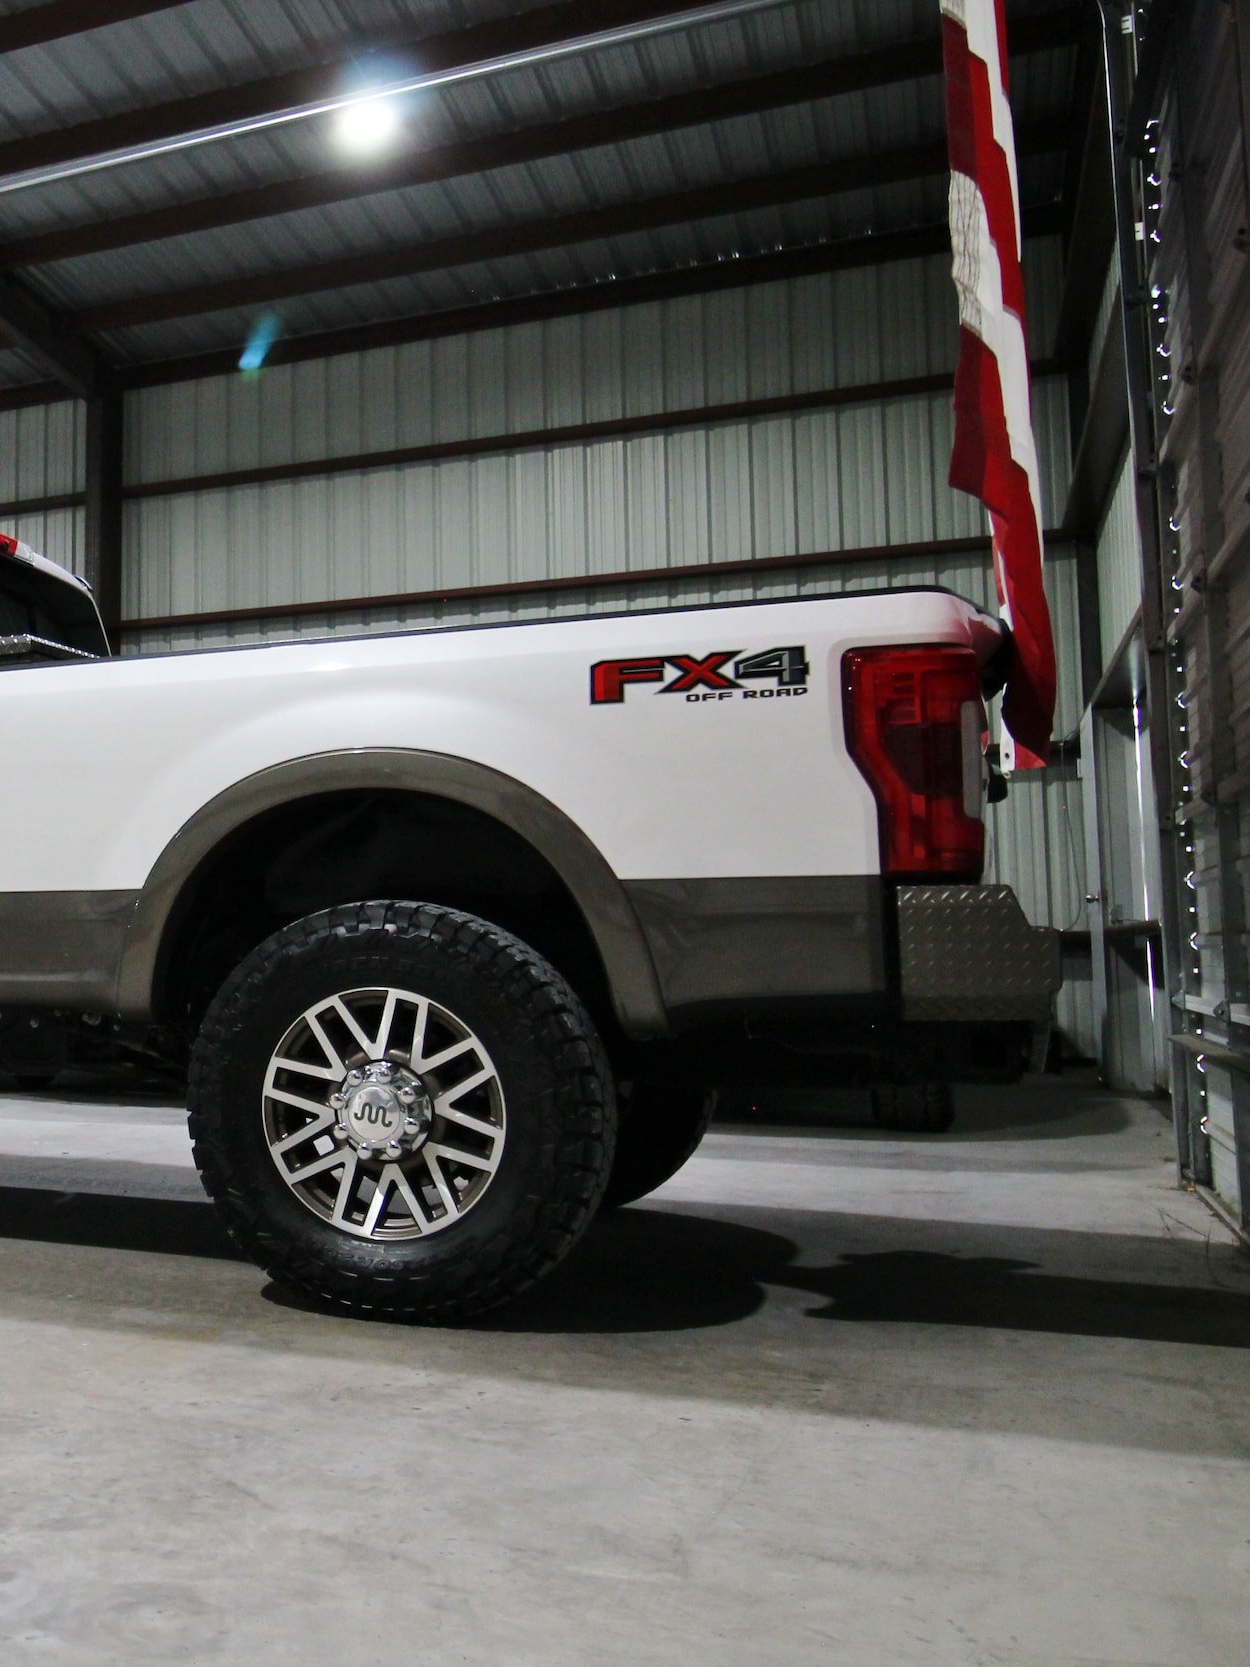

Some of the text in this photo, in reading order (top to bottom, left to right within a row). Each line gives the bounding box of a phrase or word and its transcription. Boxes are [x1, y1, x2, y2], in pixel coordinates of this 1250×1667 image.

[590, 645, 810, 705] FX4
[686, 687, 808, 702] OFF ROAD
